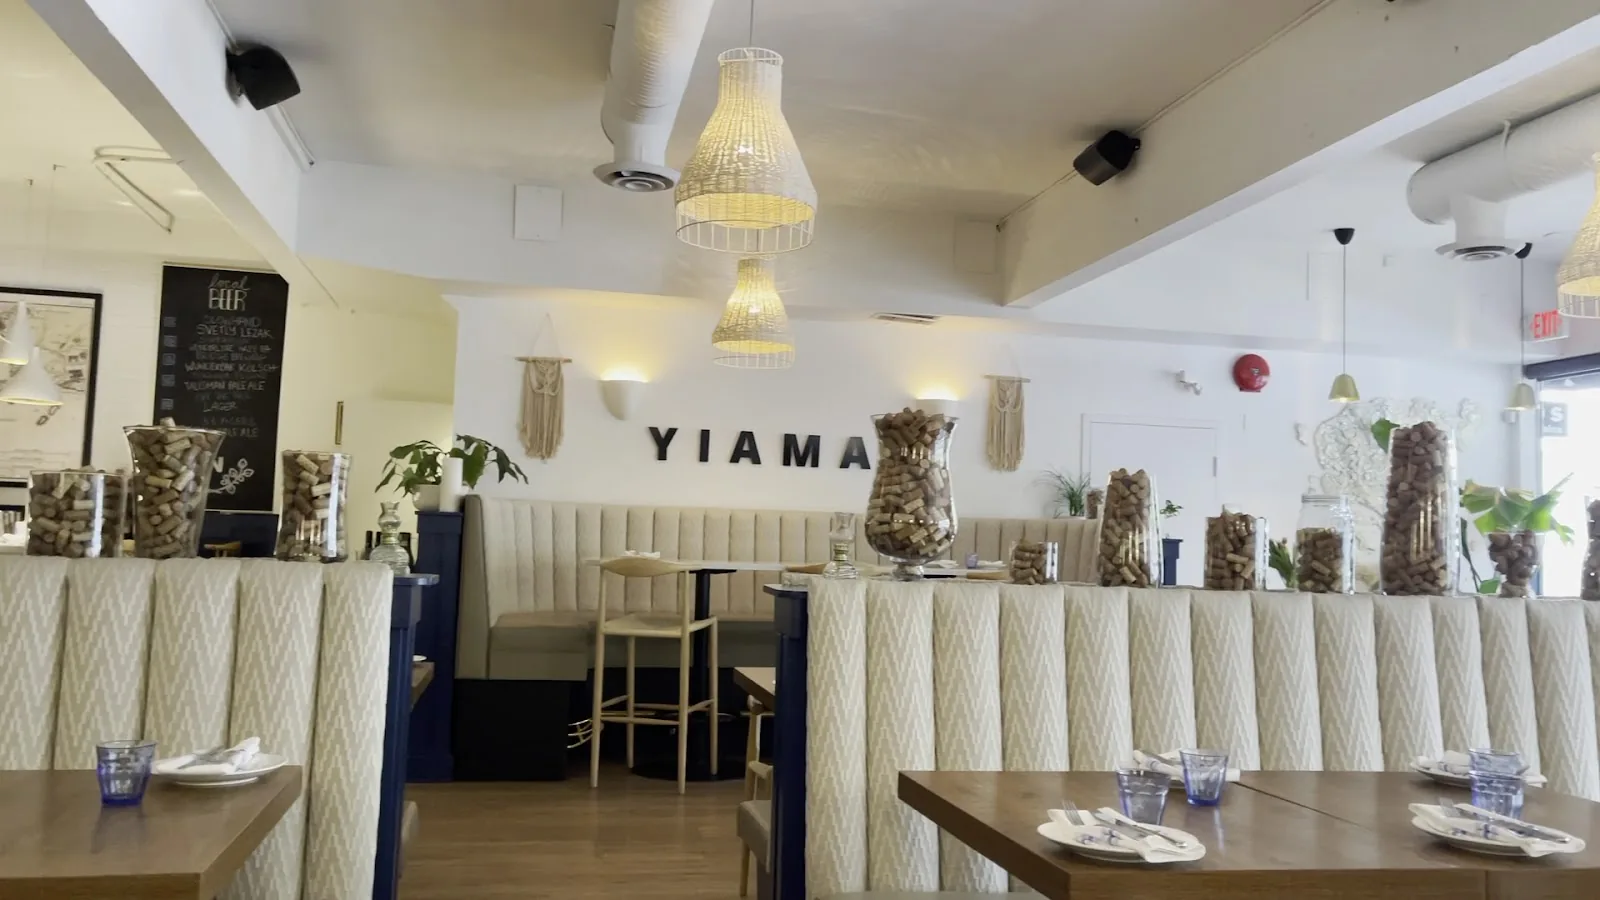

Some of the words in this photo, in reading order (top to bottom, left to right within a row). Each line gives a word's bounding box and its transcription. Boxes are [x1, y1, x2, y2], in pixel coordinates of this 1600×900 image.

[208, 272, 251, 291] local
[208, 287, 248, 311] BEER
[1533, 309, 1559, 339] EXIT
